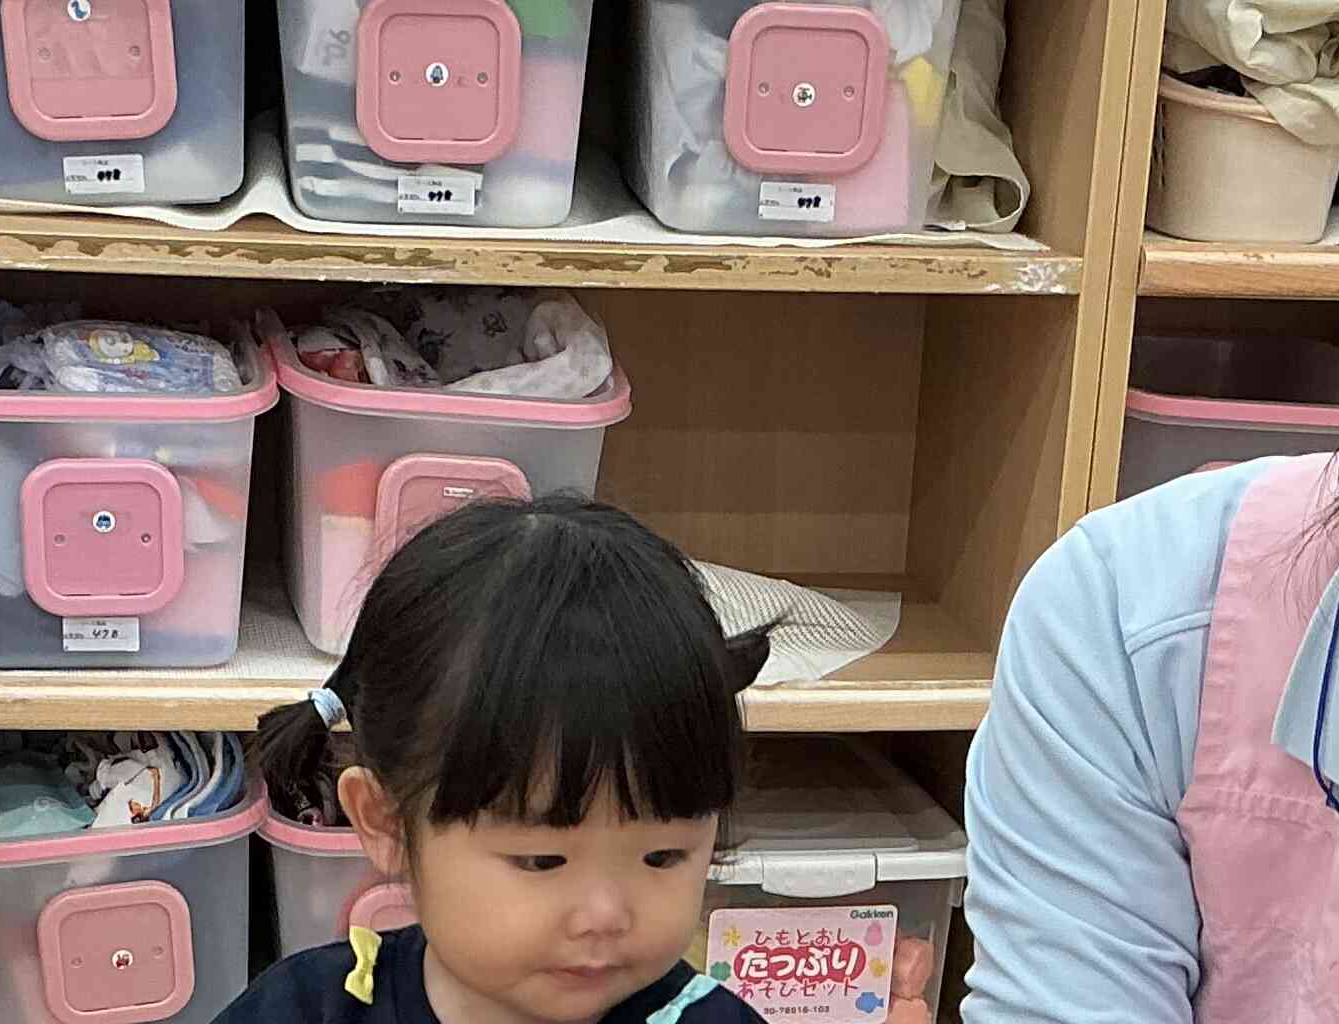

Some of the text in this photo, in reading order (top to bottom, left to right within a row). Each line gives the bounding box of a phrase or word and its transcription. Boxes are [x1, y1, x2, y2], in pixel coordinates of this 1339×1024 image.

[849, 908, 894, 920] Gakken
[754, 927, 849, 946] ひもとおし
[738, 976, 859, 1000] あそびセット
